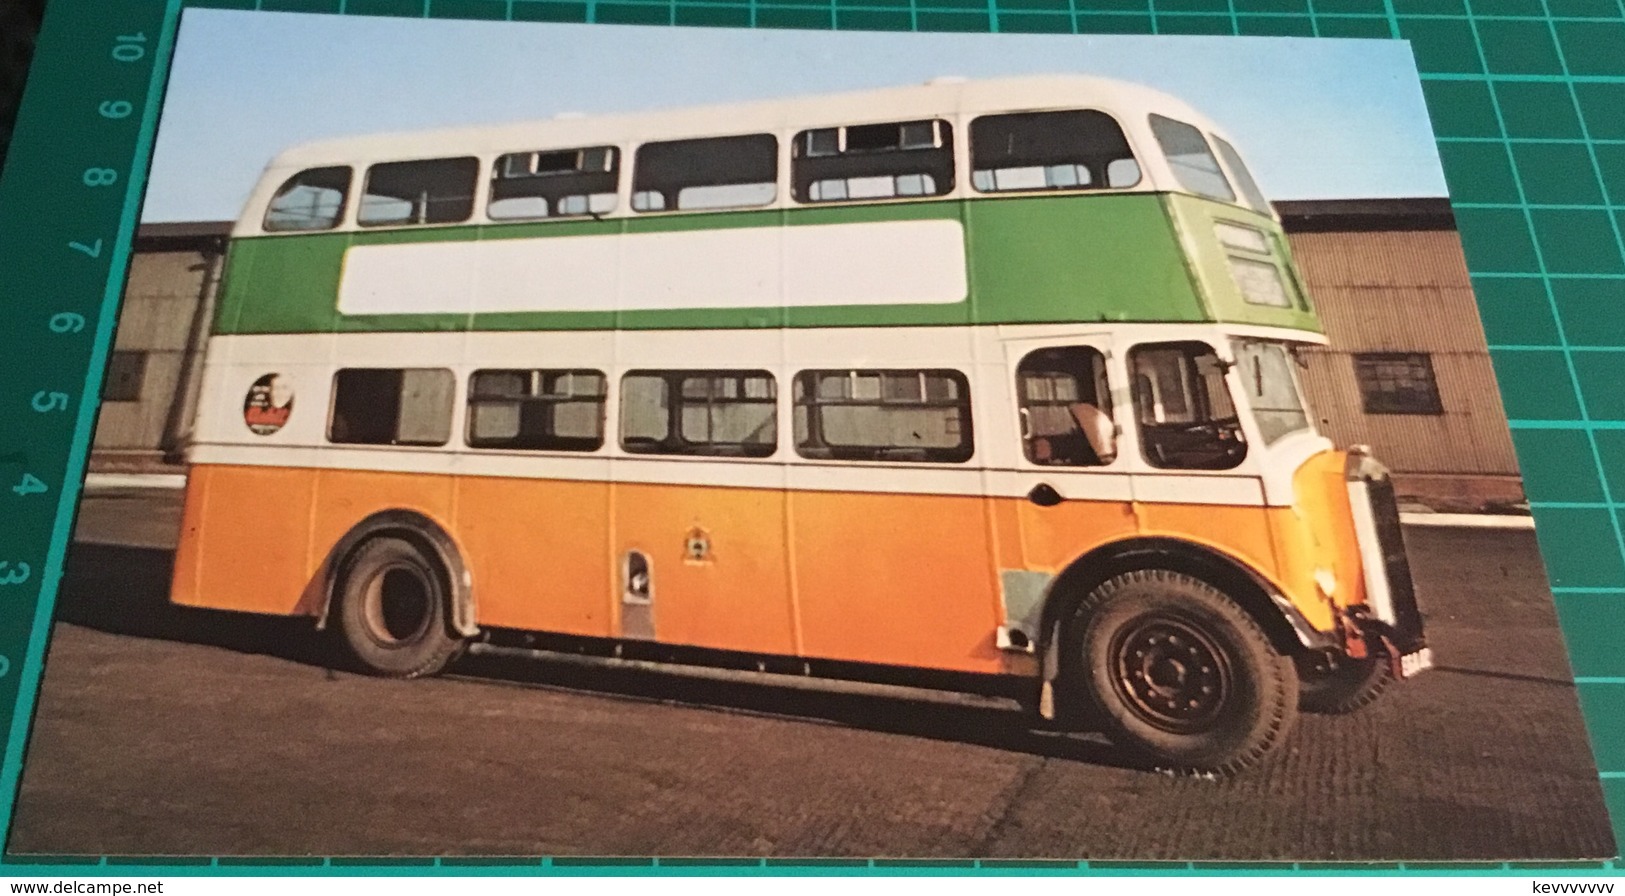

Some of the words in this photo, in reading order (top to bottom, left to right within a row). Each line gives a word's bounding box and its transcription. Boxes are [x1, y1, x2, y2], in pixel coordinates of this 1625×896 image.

[112, 31, 145, 62] 10
[98, 100, 133, 119] 9
[83, 167, 117, 187] 8
[69, 238, 102, 258] 7
[49, 312, 85, 334] 6
[32, 391, 68, 413] 5
[13, 472, 48, 496] 4
